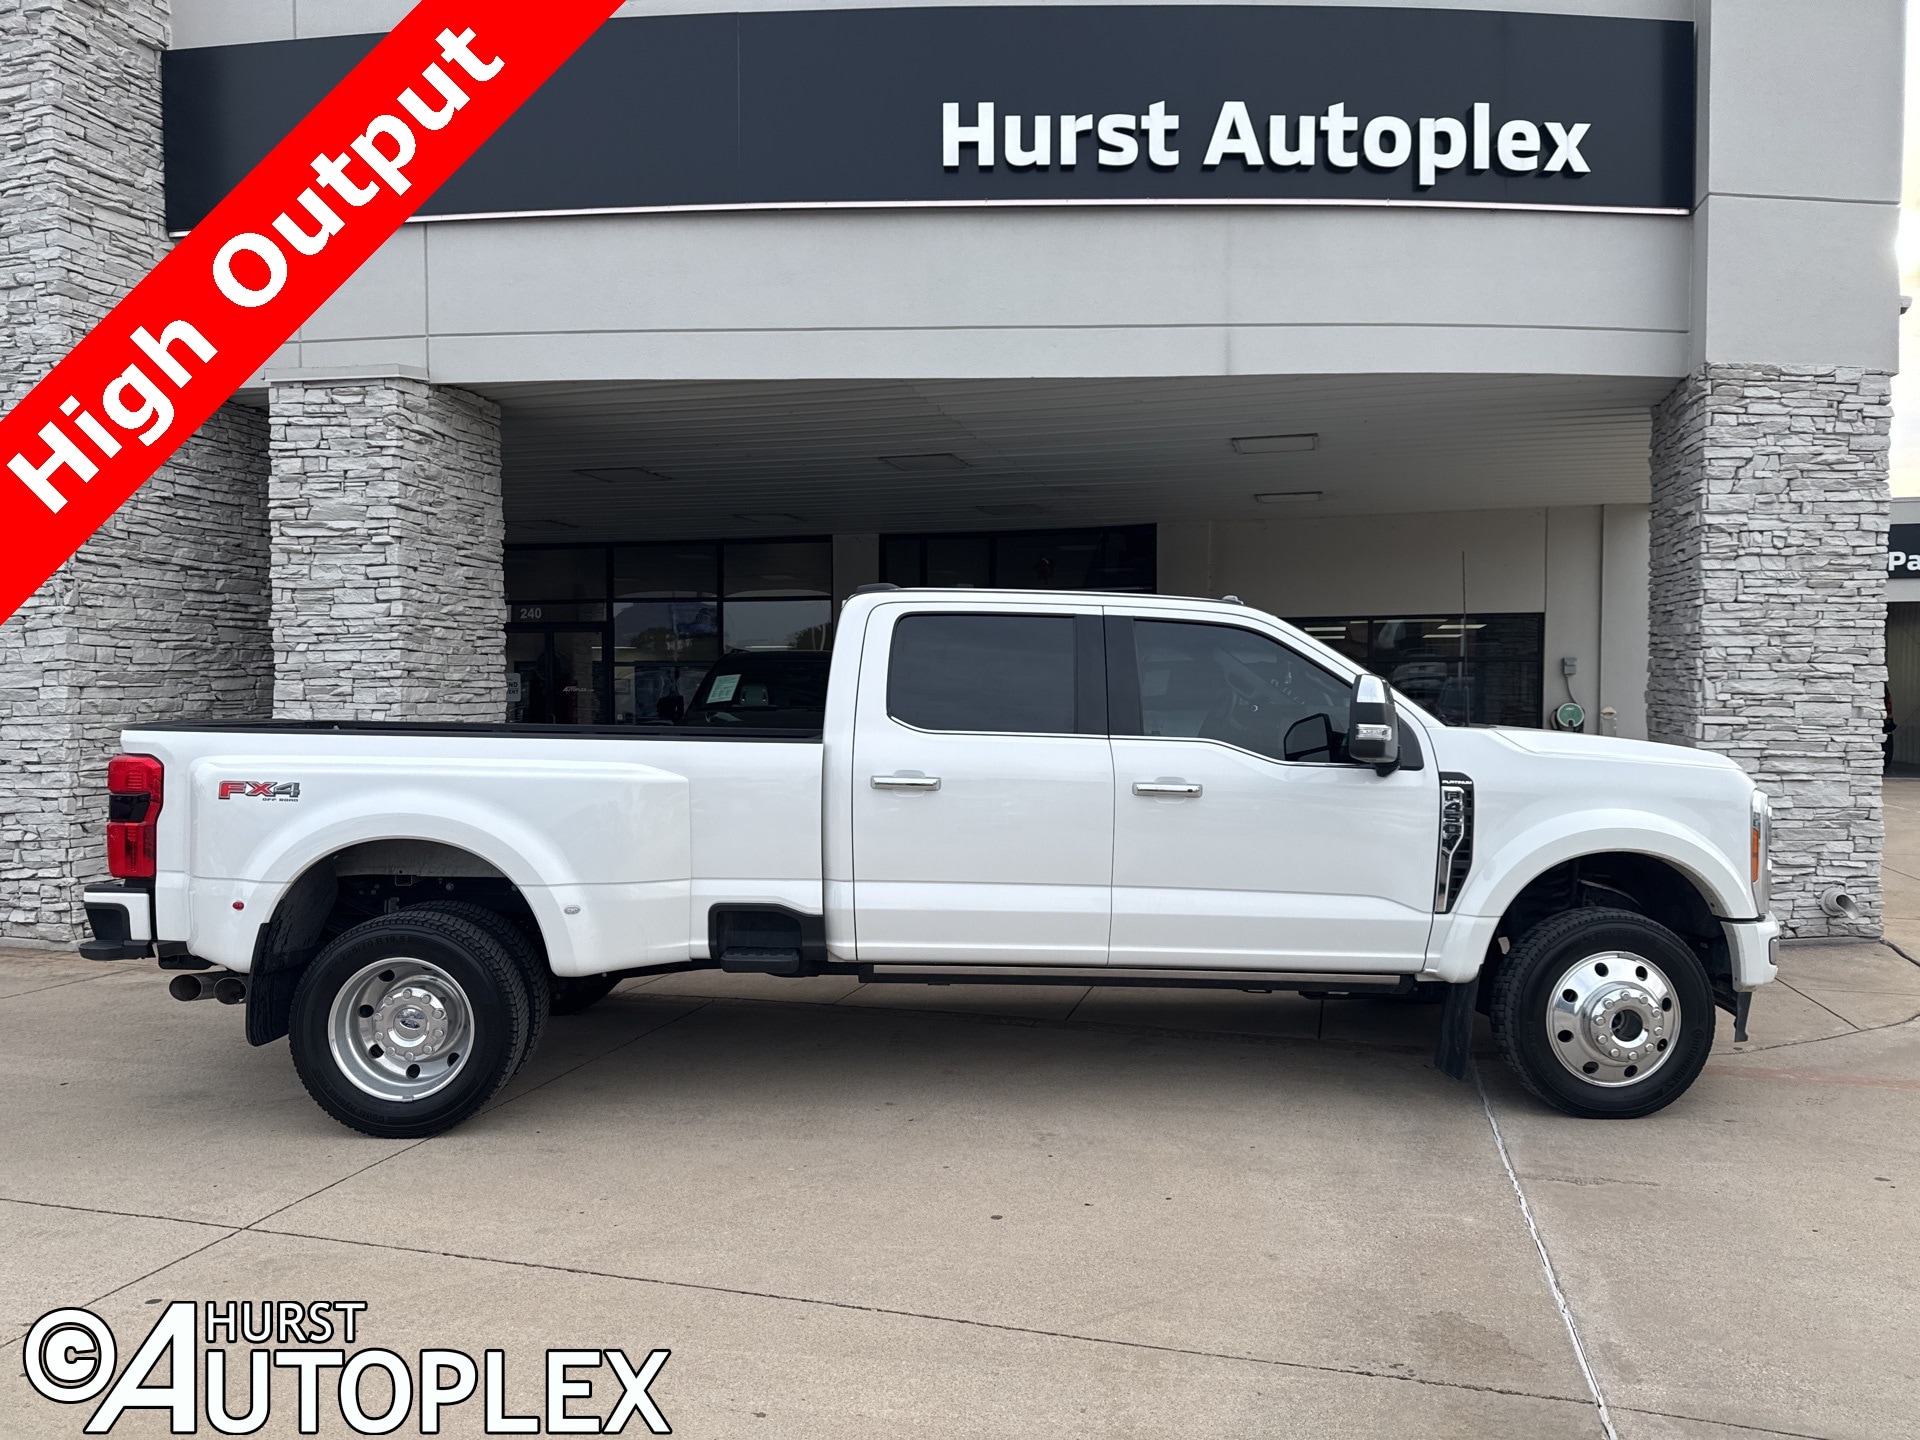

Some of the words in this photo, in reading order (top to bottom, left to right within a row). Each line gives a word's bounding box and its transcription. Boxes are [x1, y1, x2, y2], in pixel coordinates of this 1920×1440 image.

[942, 101, 1180, 168] Hurst
[1202, 101, 1592, 186] Autoplex
[1888, 551, 1920, 571] Pa
[520, 608, 542, 619] 240
[218, 780, 301, 800] FX4
